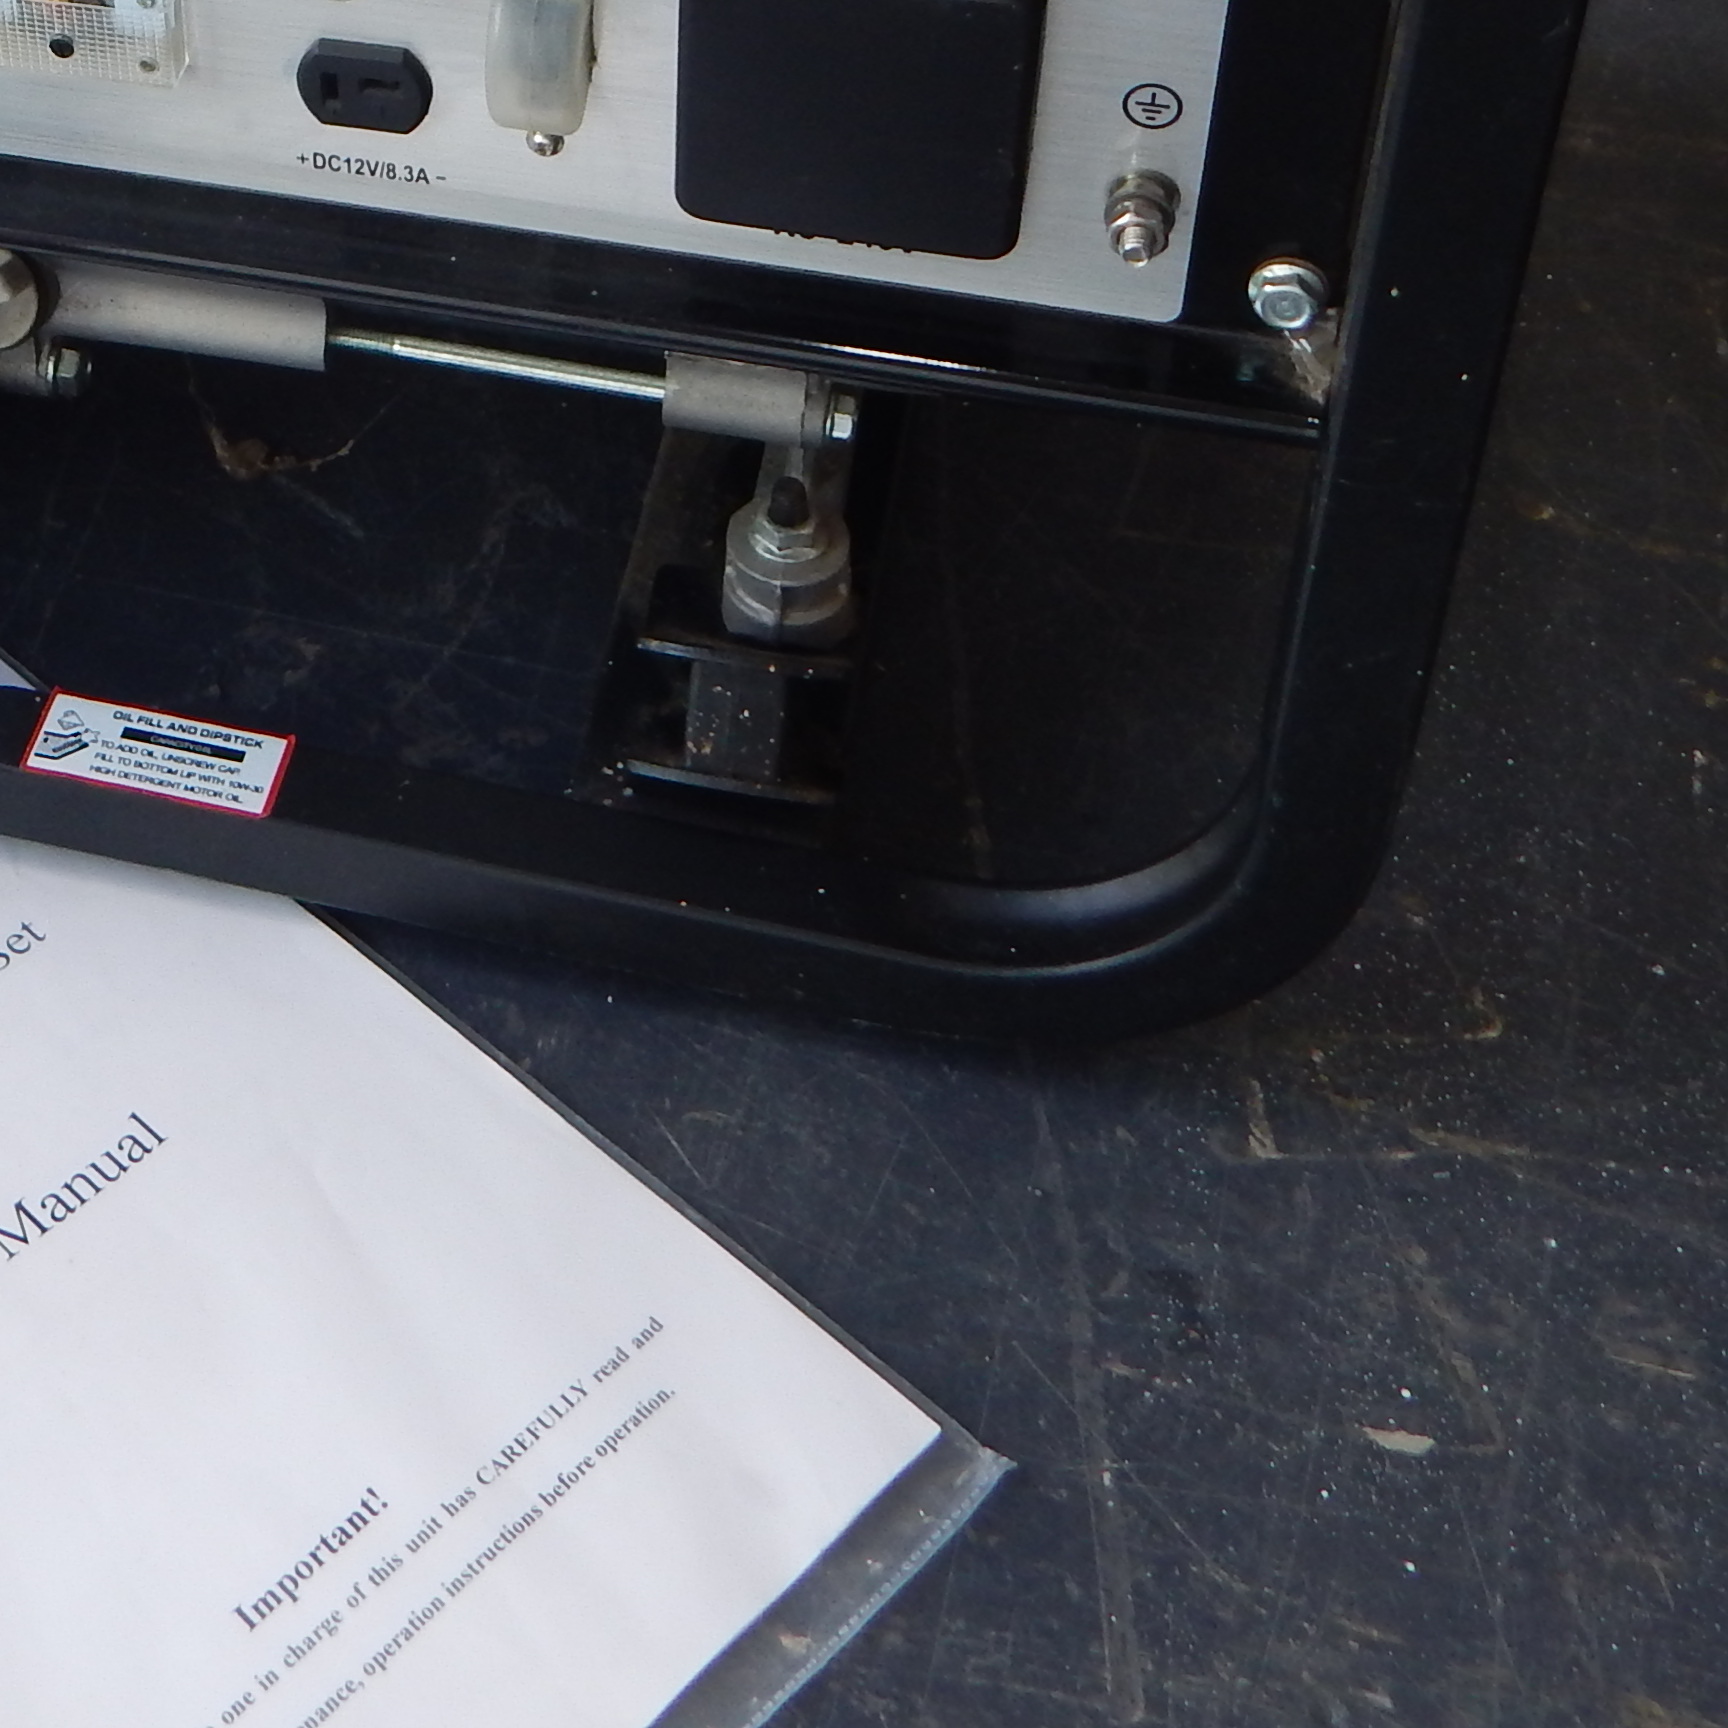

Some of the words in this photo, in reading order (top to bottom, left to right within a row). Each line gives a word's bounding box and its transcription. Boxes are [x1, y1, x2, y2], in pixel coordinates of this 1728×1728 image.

[113, 709, 135, 723] OIL
[136, 714, 163, 729] FILL
[166, 721, 198, 736] AND
[199, 728, 265, 750] DIPSTICK
[94, 752, 114, 763] FILL
[118, 756, 132, 766] TO
[133, 759, 179, 776] BOTTOM
[198, 772, 226, 785] WITH
[101, 739, 115, 750] TO
[115, 744, 139, 755] ADD
[161, 752, 217, 770] UNSCREW
[89, 765, 117, 778] HIGH
[117, 769, 181, 790] DETERGENT
[183, 783, 224, 800] MOTOR
[221, 1690, 257, 1726] one
[253, 1668, 280, 1692] in
[282, 1608, 344, 1669] charge
[346, 1581, 368, 1610] of
[367, 1551, 405, 1589] this
[404, 1515, 445, 1556] unit
[439, 1482, 478, 1520] has
[474, 1377, 590, 1488] CAREFULLY
[590, 1344, 633, 1385] read
[629, 1313, 666, 1352] and
[361, 1591, 448, 1677] operation
[444, 1498, 546, 1600] instructions
[539, 1451, 598, 1510] before
[592, 1384, 676, 1459] operation.
[232, 1485, 389, 1633] Important!
